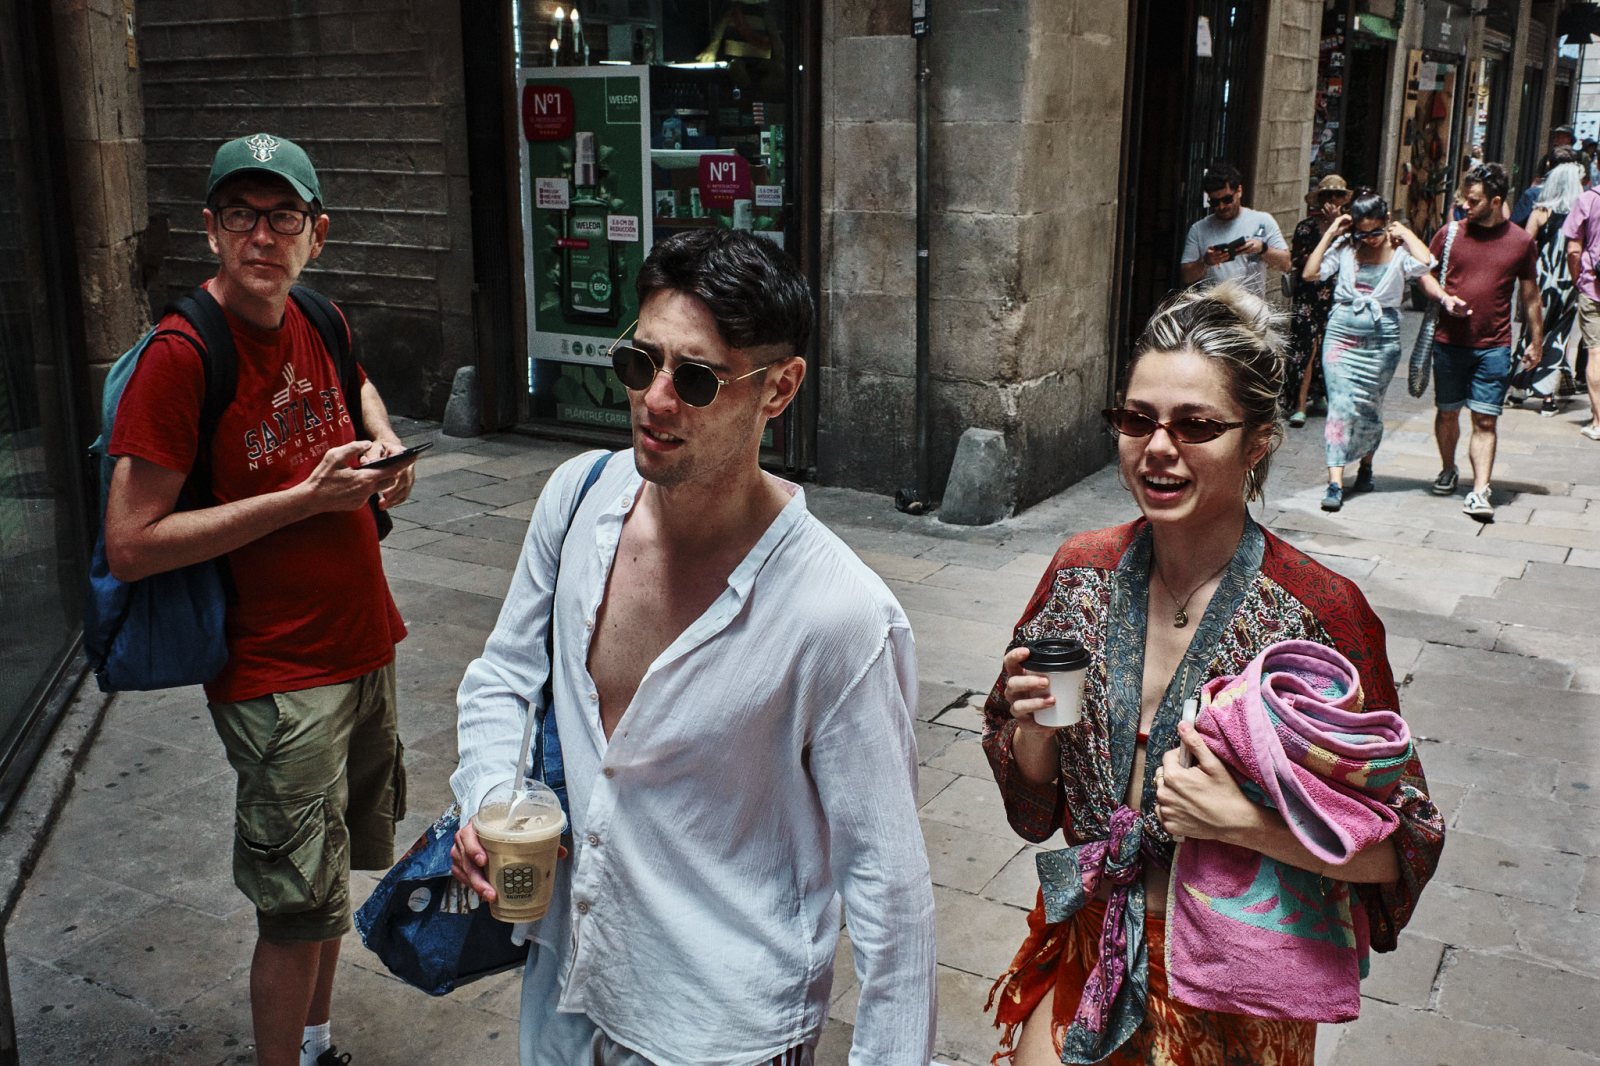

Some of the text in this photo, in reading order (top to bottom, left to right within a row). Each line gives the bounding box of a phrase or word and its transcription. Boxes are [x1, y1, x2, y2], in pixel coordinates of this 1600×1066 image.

[608, 95, 639, 105] WELEDA
[576, 221, 601, 230] WELEDA
[244, 396, 322, 460] SANTA
[248, 449, 286, 471] NEW
